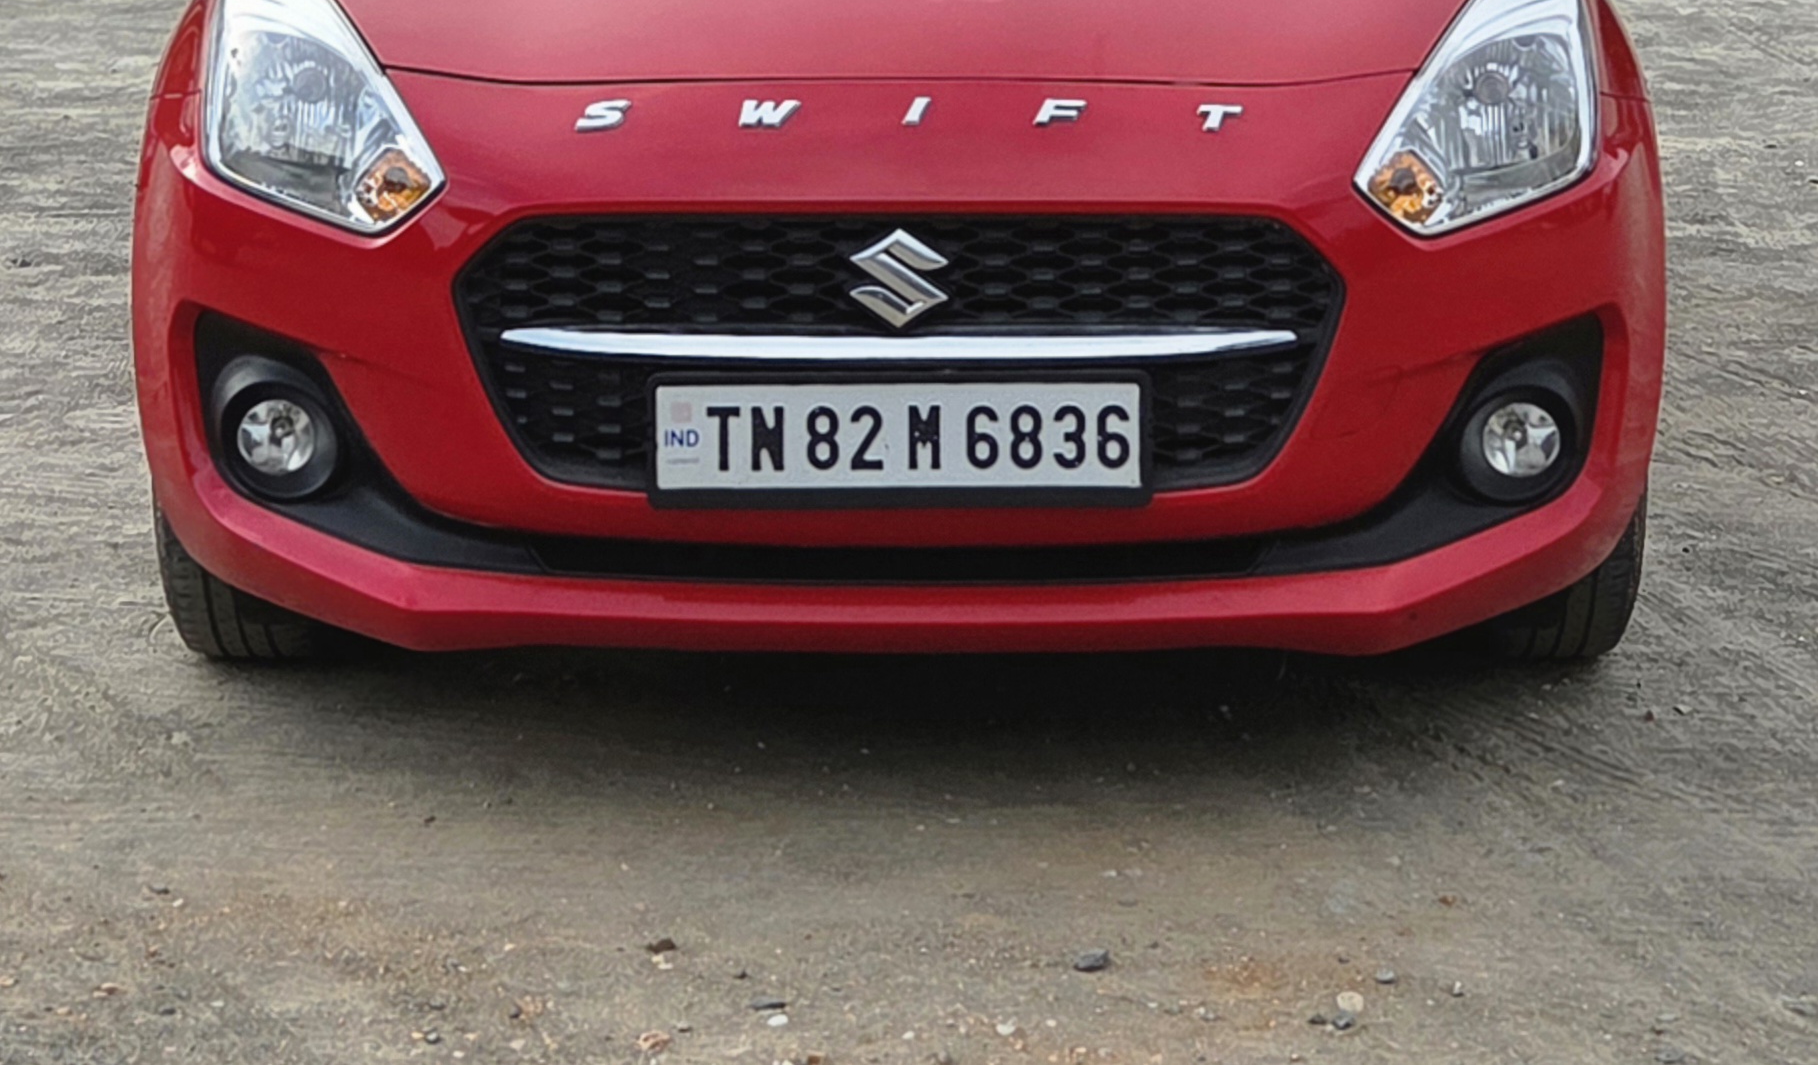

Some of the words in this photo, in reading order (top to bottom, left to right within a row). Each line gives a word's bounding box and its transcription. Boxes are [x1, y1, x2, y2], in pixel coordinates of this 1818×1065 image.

[574, 98, 1243, 132] SWIFT
[664, 429, 700, 447] IND
[706, 406, 785, 471] TN
[806, 406, 884, 470] 82
[908, 405, 941, 470] M
[966, 405, 1130, 470] 6836
